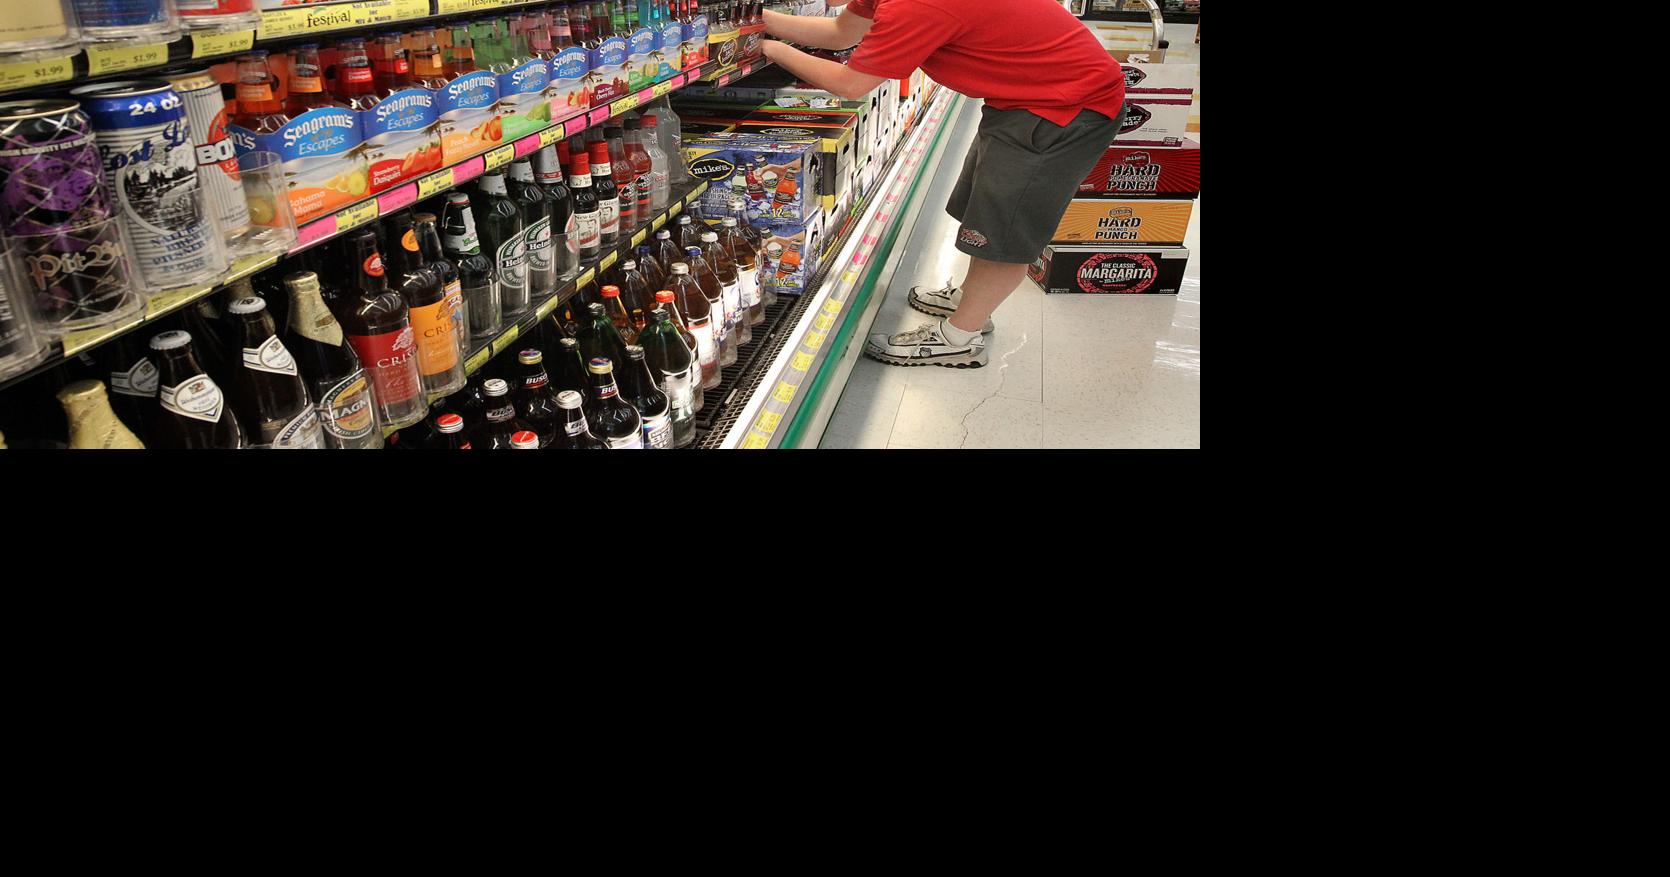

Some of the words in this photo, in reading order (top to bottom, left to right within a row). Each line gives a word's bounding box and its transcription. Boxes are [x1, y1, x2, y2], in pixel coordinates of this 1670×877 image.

[306, 11, 351, 28] festival
[133, 53, 157, 63] $1.99
[553, 51, 586, 72] Seagram's
[34, 65, 64, 78] $1.99
[448, 76, 496, 101] Seagram's
[457, 92, 490, 108] Escapes
[129, 103, 157, 116] 24
[376, 95, 432, 123] Seagram's
[387, 112, 424, 130] Escapes
[283, 114, 354, 149] Seagram's
[299, 134, 345, 156] Escapes
[1110, 163, 1161, 176] HARD
[1106, 180, 1157, 191] PUNCH
[771, 208, 783, 218] 12
[1098, 217, 1142, 228] HARD
[1094, 231, 1138, 240] PUNCH
[25, 252, 86, 290] Pit
[1080, 268, 1152, 279] MARGARITA
[321, 400, 367, 422] MAGN
